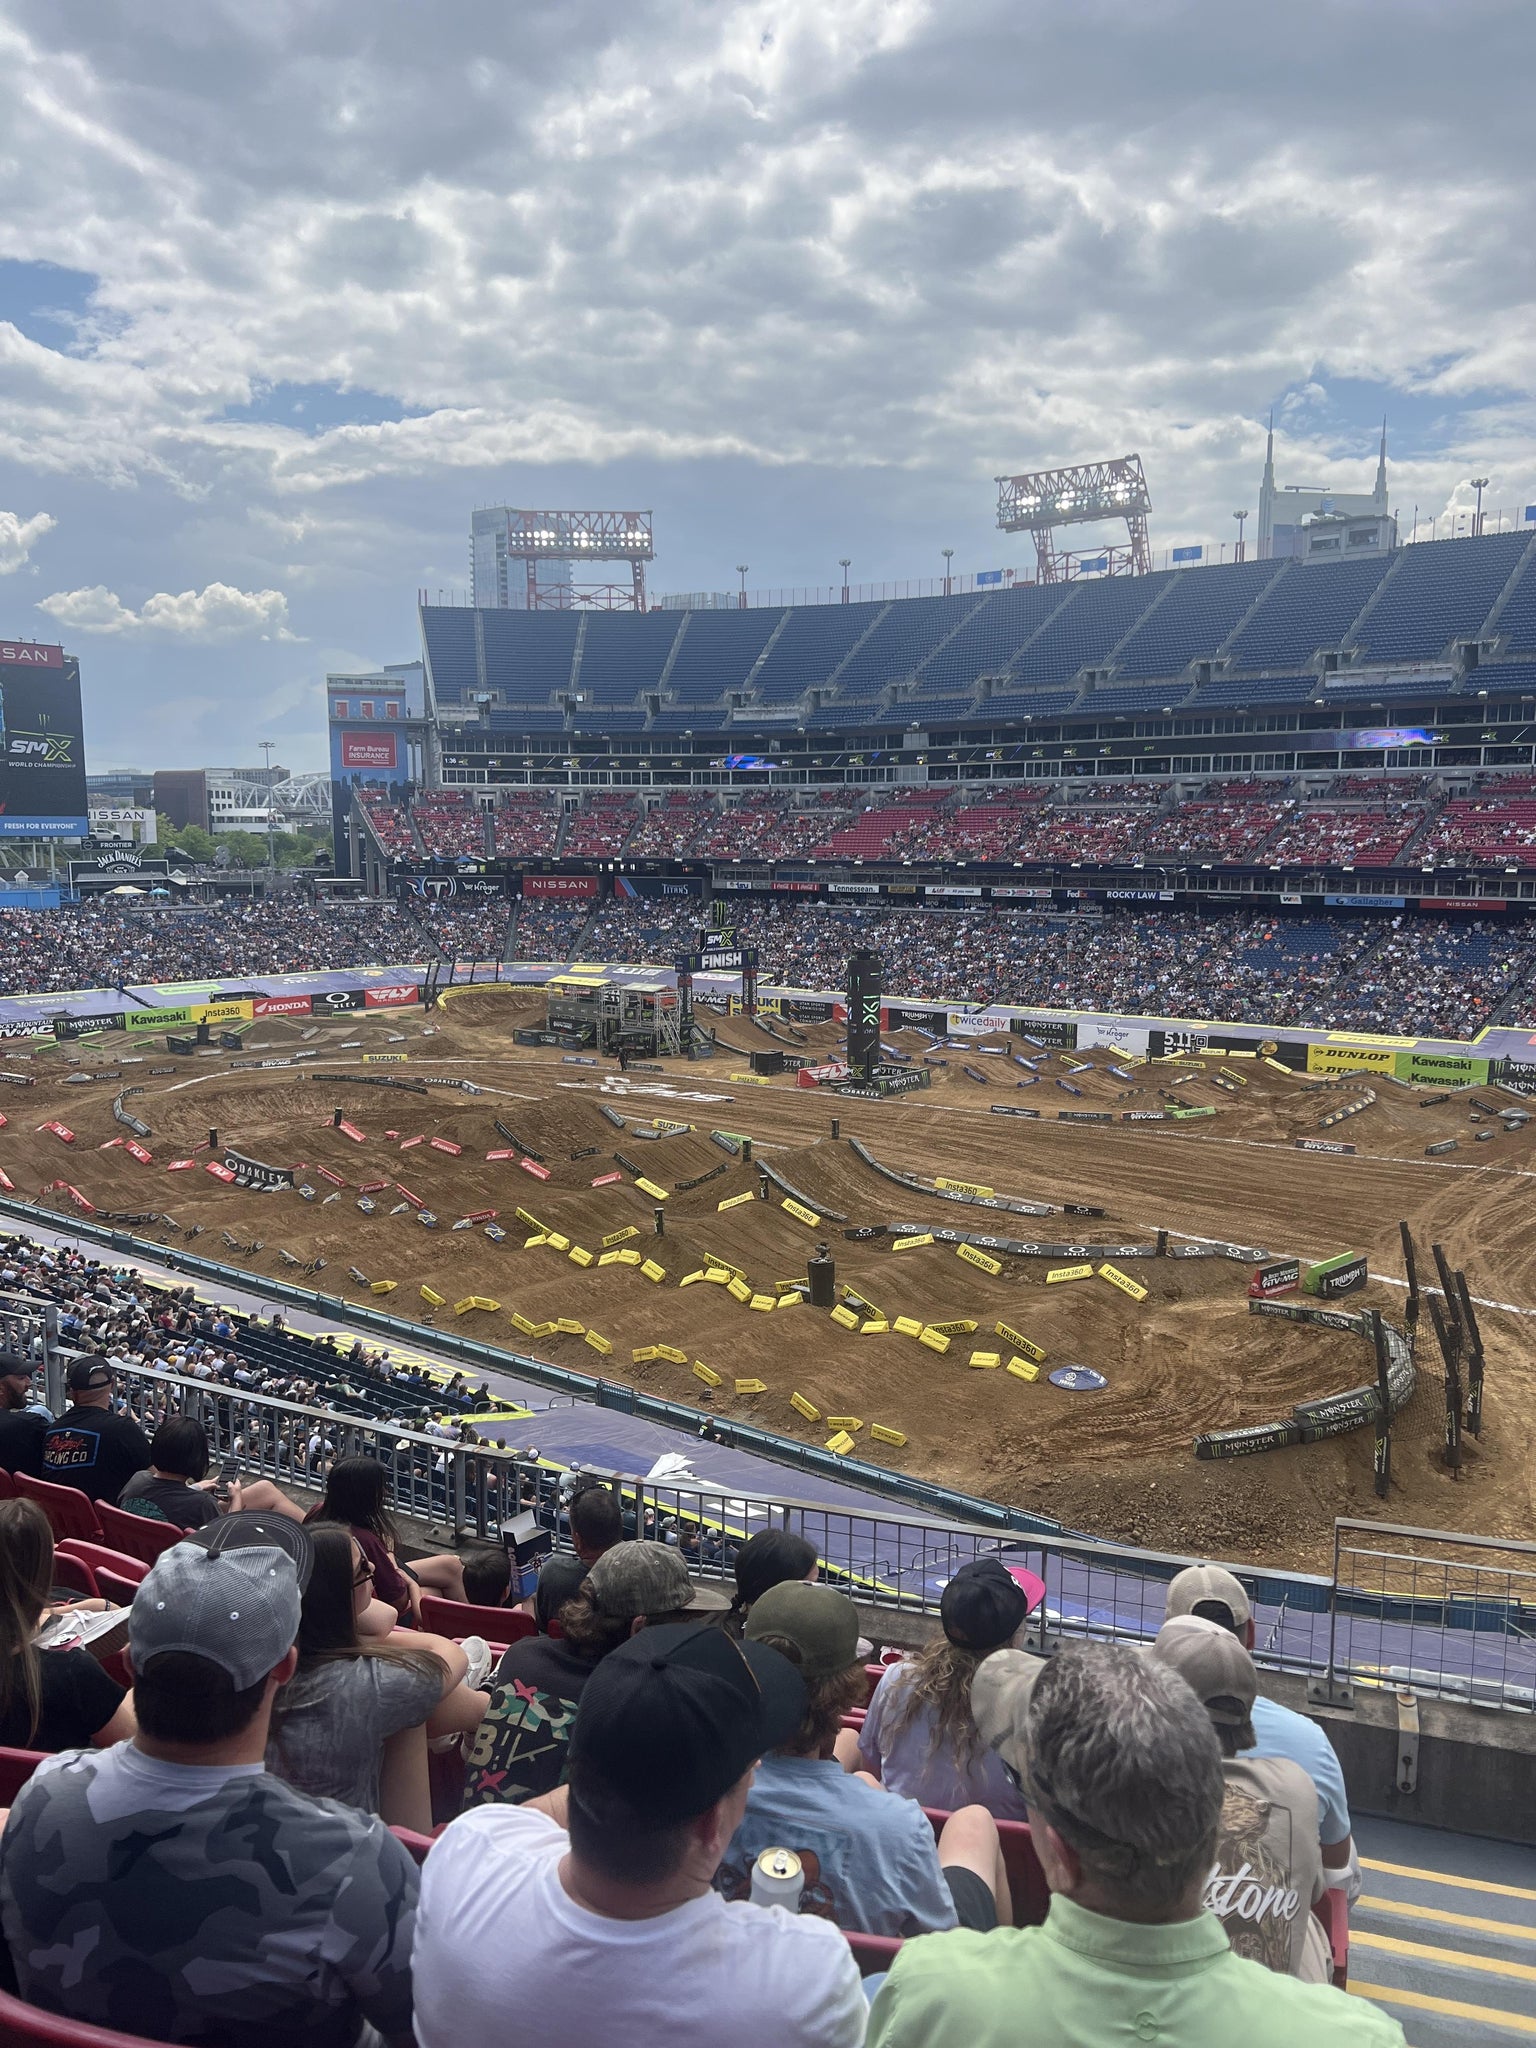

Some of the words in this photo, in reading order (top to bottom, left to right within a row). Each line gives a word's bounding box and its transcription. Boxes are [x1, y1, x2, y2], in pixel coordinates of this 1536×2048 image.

[10, 738, 72, 763] SMX
[348, 752, 390, 760] INSURANCE
[4, 822, 25, 830] FRESH
[97, 853, 116, 868] JACK
[474, 880, 500, 895] Kroger
[532, 881, 588, 889] NISSAN
[662, 883, 688, 895] TITANS
[1067, 889, 1089, 898] FedEx
[1106, 890, 1136, 899] ROCKY
[1137, 891, 1157, 900] LAW
[1351, 896, 1393, 906] Gallagher
[706, 931, 735, 947] SMX
[701, 952, 742, 969] FINISH
[378, 988, 416, 1000] FLY
[204, 1006, 241, 1018] Insta360
[268, 1001, 310, 1012] HONDA
[131, 1011, 186, 1025] Kawasaki
[901, 1011, 928, 1021] TRIUMPH
[15, 1019, 55, 1028] MOUNTAIN
[69, 1018, 113, 1029] MONSTER
[1024, 1020, 1064, 1030] MONSTER
[1106, 1028, 1130, 1041] Kroger
[1325, 1049, 1391, 1061] DUNLOP
[1412, 1055, 1473, 1070] Kawasaki
[432, 1078, 460, 1086] OAKLEY
[889, 1074, 920, 1089] MONSTER
[1411, 1073, 1471, 1087] Kawasaki
[851, 1089, 880, 1097] OAKLEY
[54, 1126, 68, 1136] FLY
[129, 1145, 146, 1158] FLY
[436, 1143, 458, 1155] HONDA
[211, 1167, 230, 1177] FLY
[239, 1163, 285, 1184] OAKLEY
[525, 1164, 546, 1180] HONDA
[43, 1184, 54, 1194] FLY
[945, 1180, 978, 1196] Insta360
[786, 1202, 814, 1222] Insta360
[606, 1229, 628, 1245] Insta360
[897, 1236, 926, 1248] Insta360
[962, 1248, 994, 1271] Insta360
[1051, 1267, 1084, 1280] Insta360
[1329, 1268, 1360, 1288] TRIUMPH
[1105, 1268, 1140, 1296] Insta360
[1000, 1327, 1037, 1357] Insta360
[1319, 1398, 1363, 1418] MONSTER
[1326, 1416, 1366, 1434] MONSTER
[1225, 1435, 1275, 1451] MONSTER
[71, 1451, 90, 1463] CO
